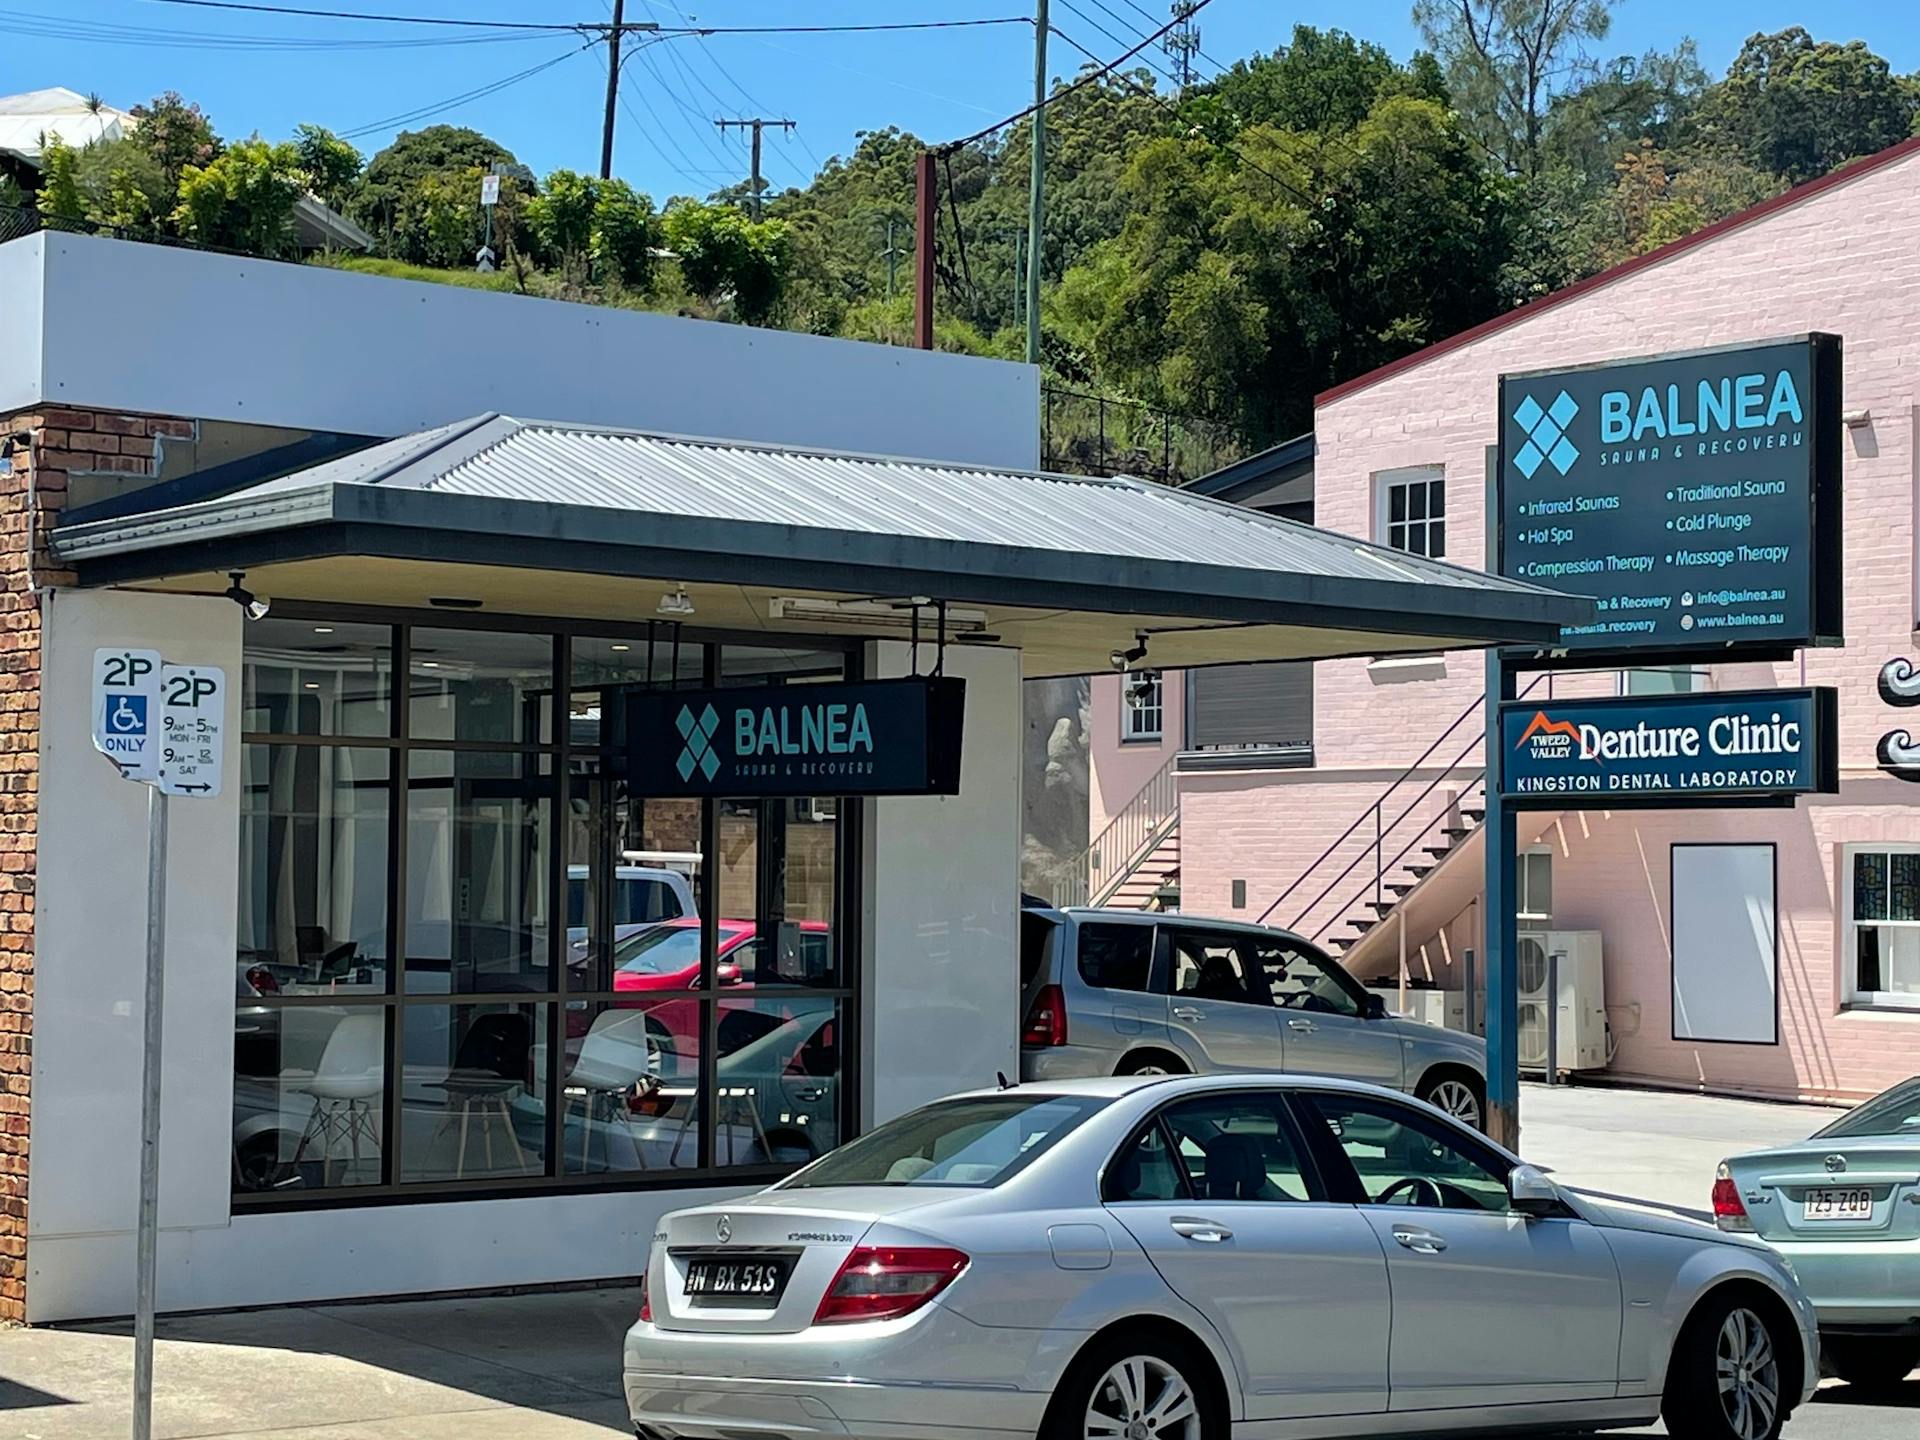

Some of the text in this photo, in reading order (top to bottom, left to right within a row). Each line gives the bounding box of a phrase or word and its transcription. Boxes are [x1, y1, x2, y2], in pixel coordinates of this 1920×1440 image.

[1600, 369, 1803, 444] BALNEA
[1600, 431, 1803, 467] SAUNA & RECOVERY
[1676, 480, 1786, 503] Traditional Sauna
[1527, 495, 1620, 516] Infrared Saunas
[1675, 512, 1752, 532] Cold Plunge
[1527, 527, 1574, 546] Hot Spa
[1527, 554, 1655, 578] Compression Therapy
[1675, 544, 1790, 568] Massage Therapy
[1609, 596, 1619, 610] &
[1620, 596, 1672, 610] Recovery
[1697, 588, 1787, 606] info@balnea.au
[1696, 612, 1785, 628] www.balnea.au
[103, 658, 153, 686] 2P
[167, 677, 217, 707] 2P
[169, 733, 190, 743] MON
[197, 734, 211, 744] FRI
[734, 702, 874, 756] BALNEA
[1578, 712, 1802, 761] Denture Clinic
[105, 739, 146, 751] ONLY
[1530, 734, 1571, 747] TWEED
[1529, 746, 1572, 759] VALLEY
[178, 765, 198, 775] SAT
[801, 761, 874, 776] RECOVERY
[1516, 768, 1798, 792] KINGSTON DENTAL LABORATORY
